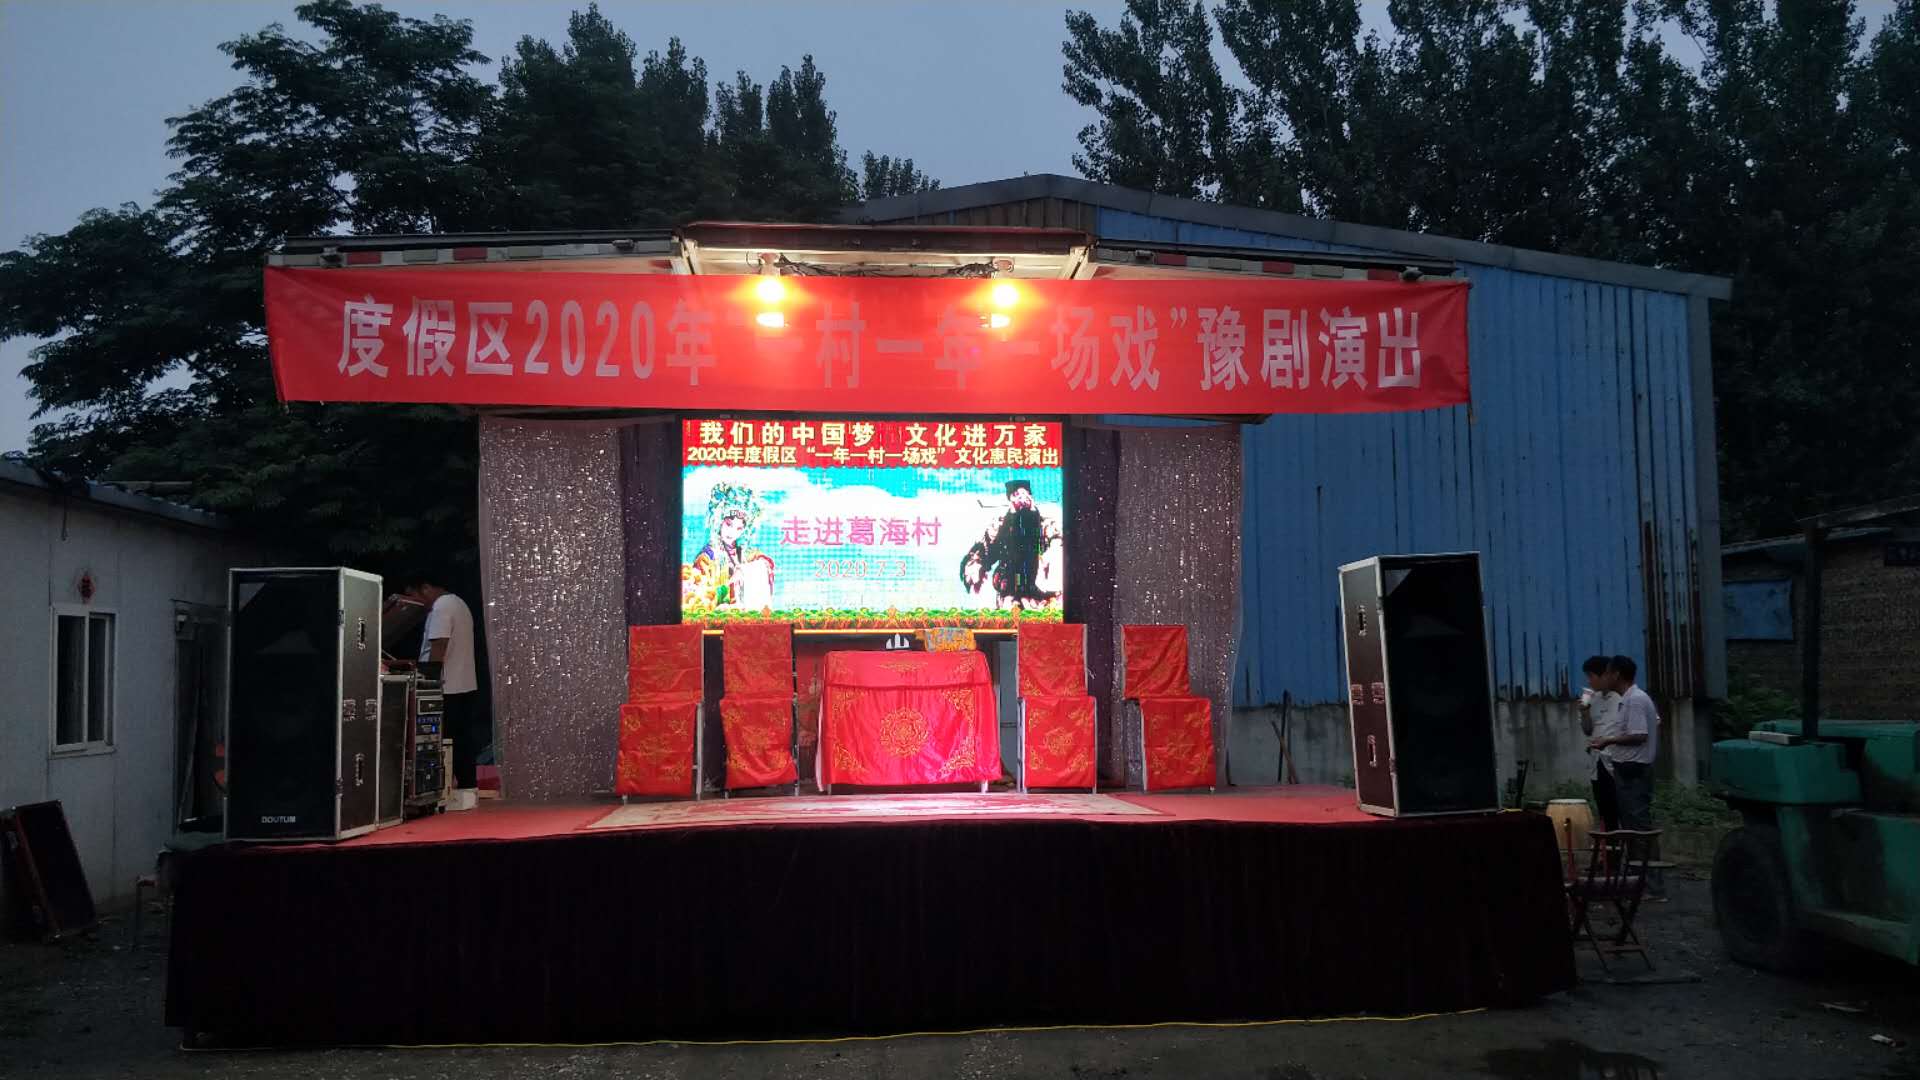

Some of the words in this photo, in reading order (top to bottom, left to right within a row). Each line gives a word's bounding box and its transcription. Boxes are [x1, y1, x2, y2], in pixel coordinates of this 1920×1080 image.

[700, 421, 875, 446] 我们的中国梦
[905, 422, 1047, 447] 文化进万家
[780, 516, 942, 546] 走进葛海村
